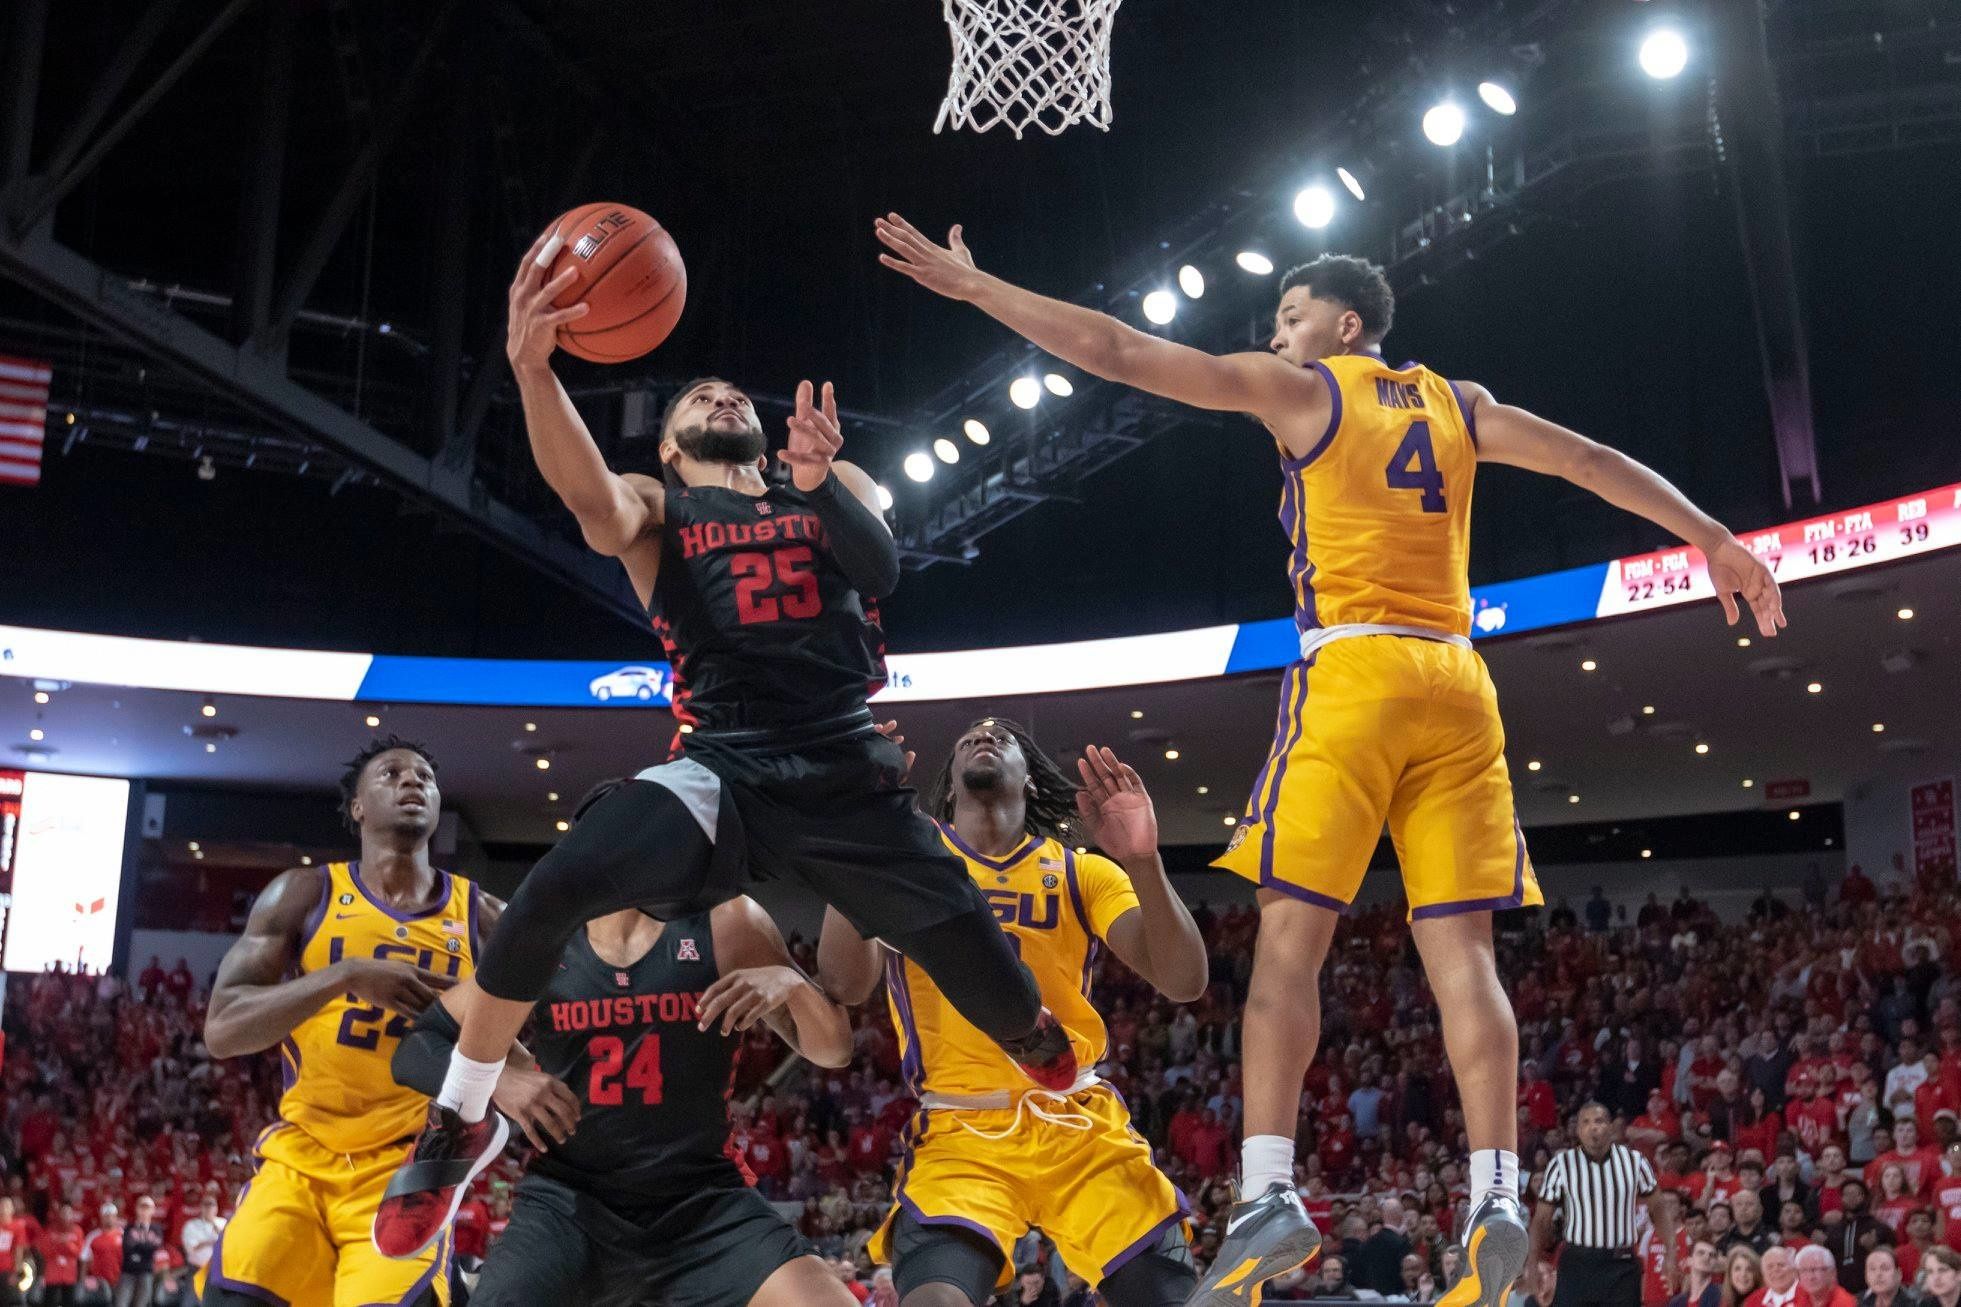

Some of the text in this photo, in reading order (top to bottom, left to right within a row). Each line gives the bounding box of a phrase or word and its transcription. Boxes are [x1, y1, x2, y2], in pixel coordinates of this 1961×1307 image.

[1375, 376, 1425, 408] MAYS
[1386, 421, 1447, 513] 4
[678, 514, 824, 559] HOUSTO
[1901, 524, 1929, 546] 39
[730, 547, 823, 625] 25
[982, 889, 1060, 930] SU
[588, 1033, 663, 1106] 24
